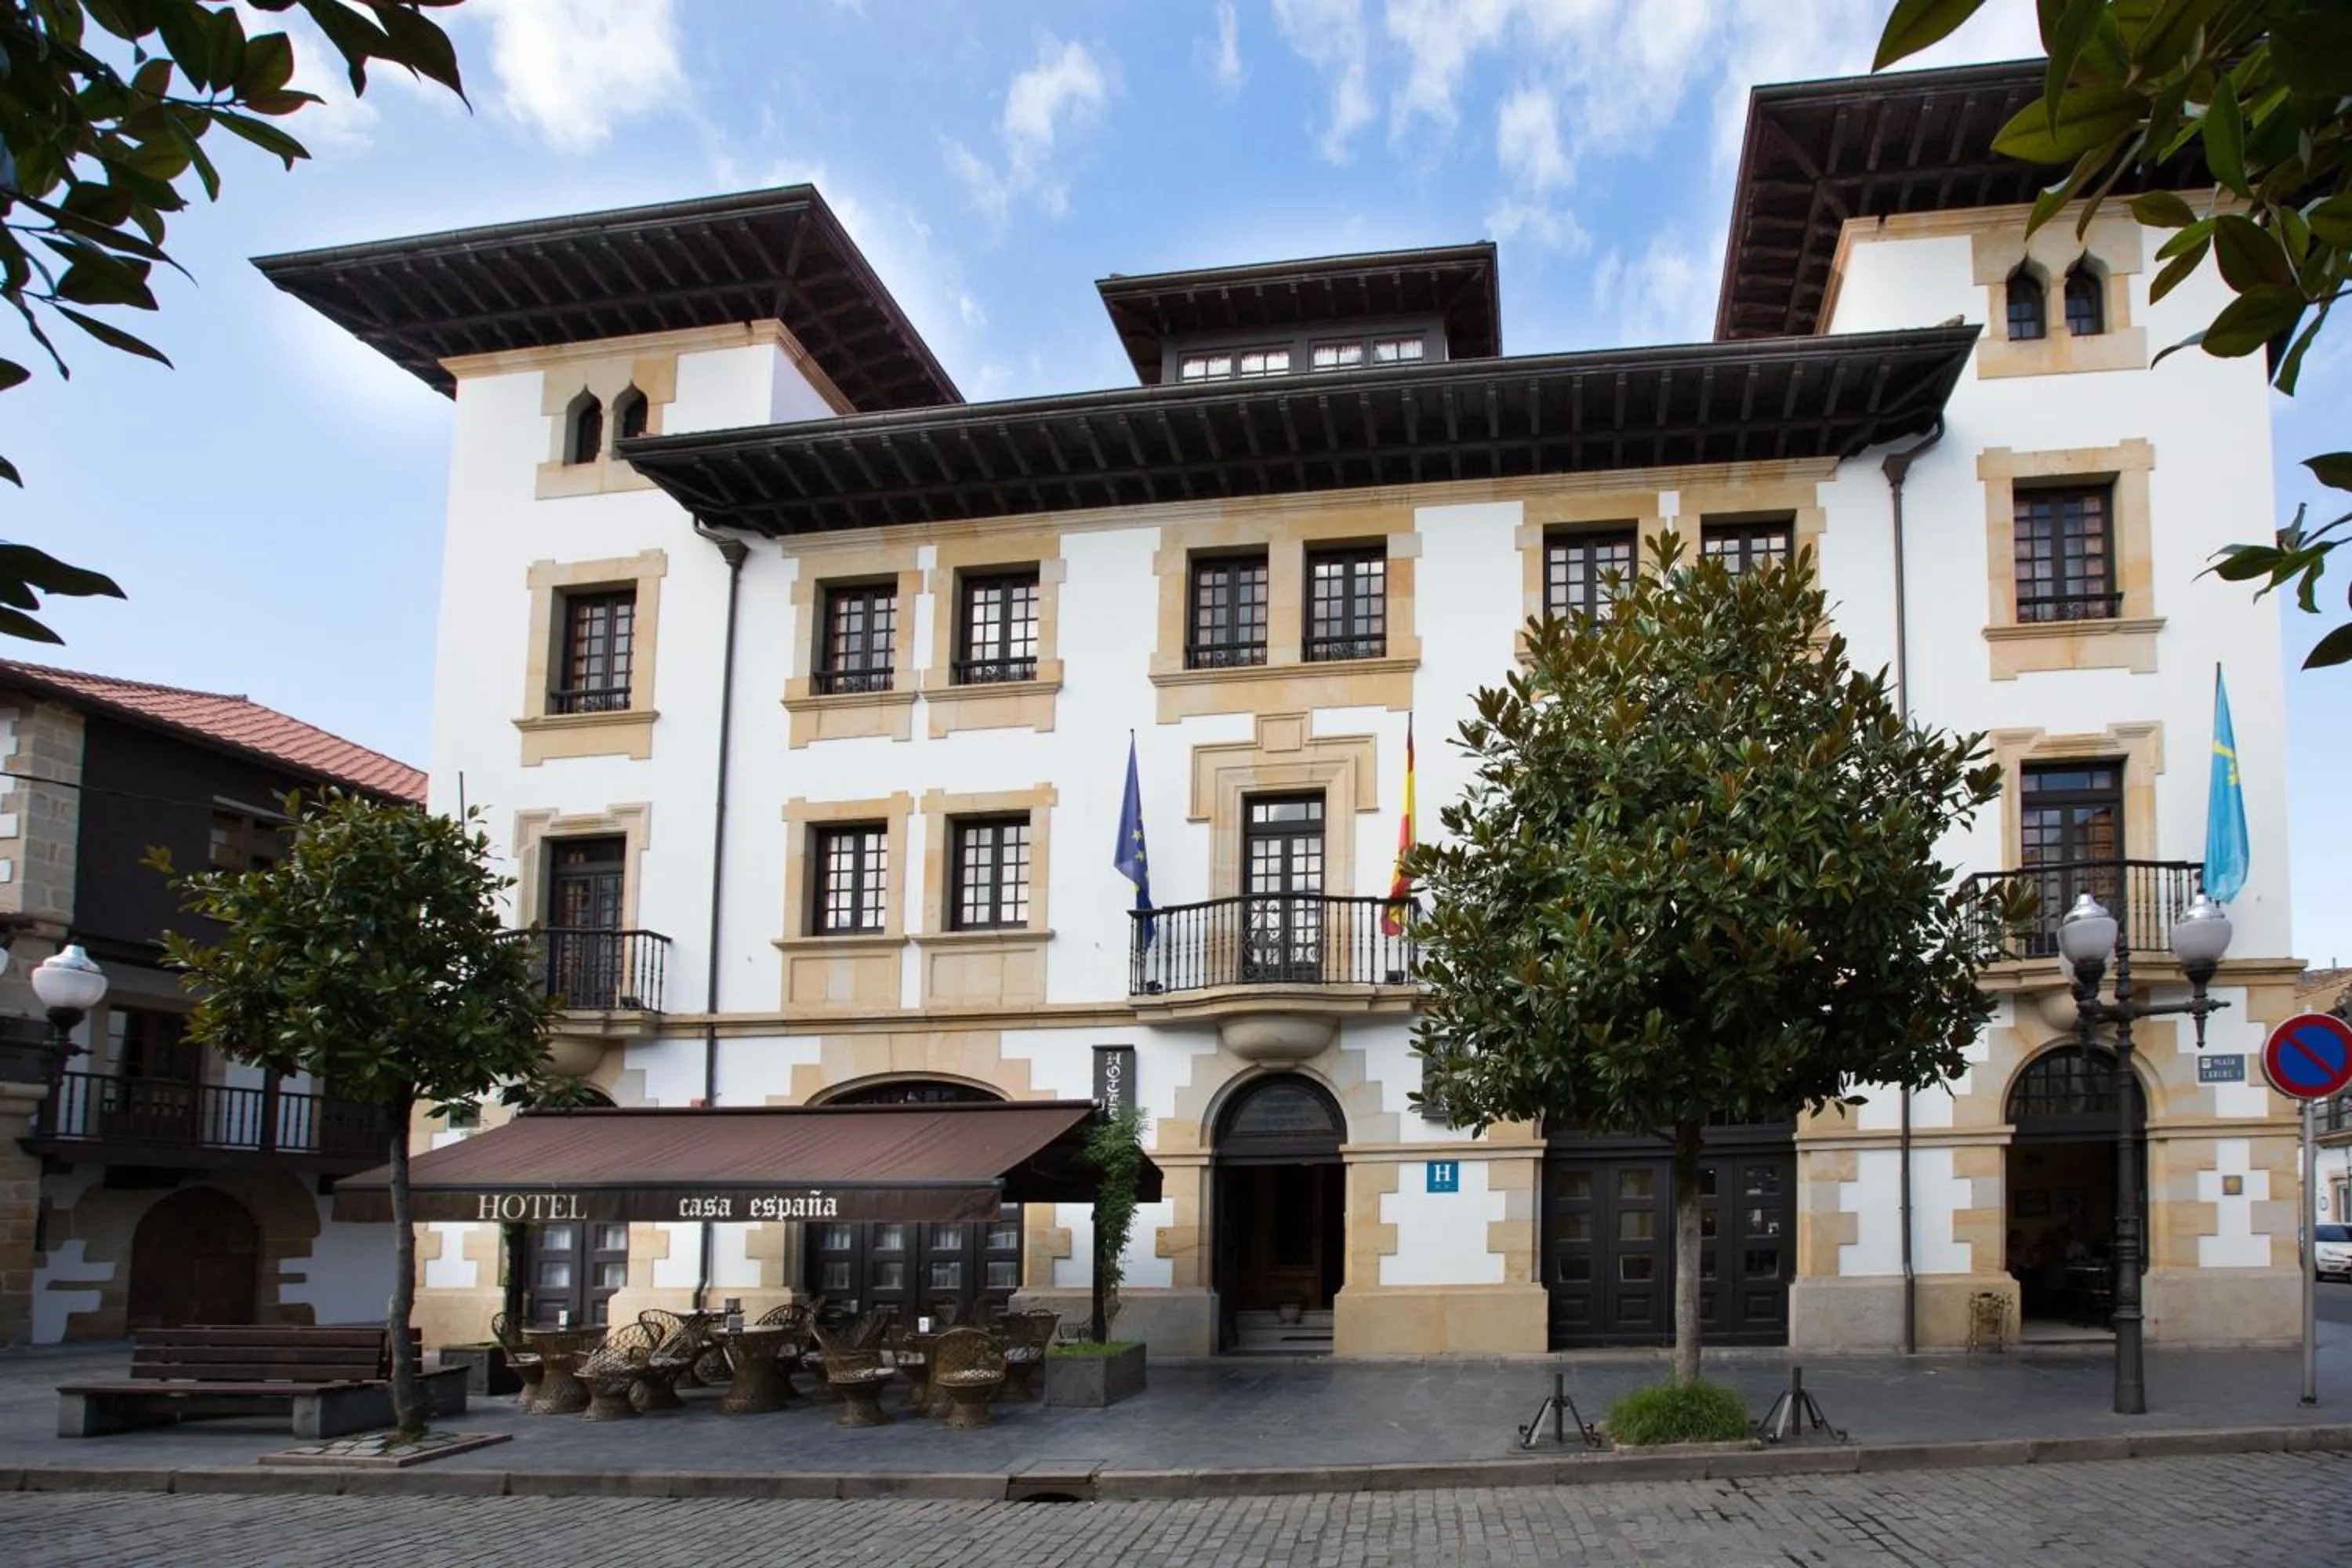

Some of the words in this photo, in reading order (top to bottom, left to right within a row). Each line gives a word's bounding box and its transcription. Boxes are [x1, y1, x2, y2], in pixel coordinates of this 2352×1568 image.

[1433, 1163, 1452, 1181] H
[477, 1194, 587, 1220] HOTEL
[678, 1195, 732, 1218] casa
[750, 1189, 838, 1221] españa
